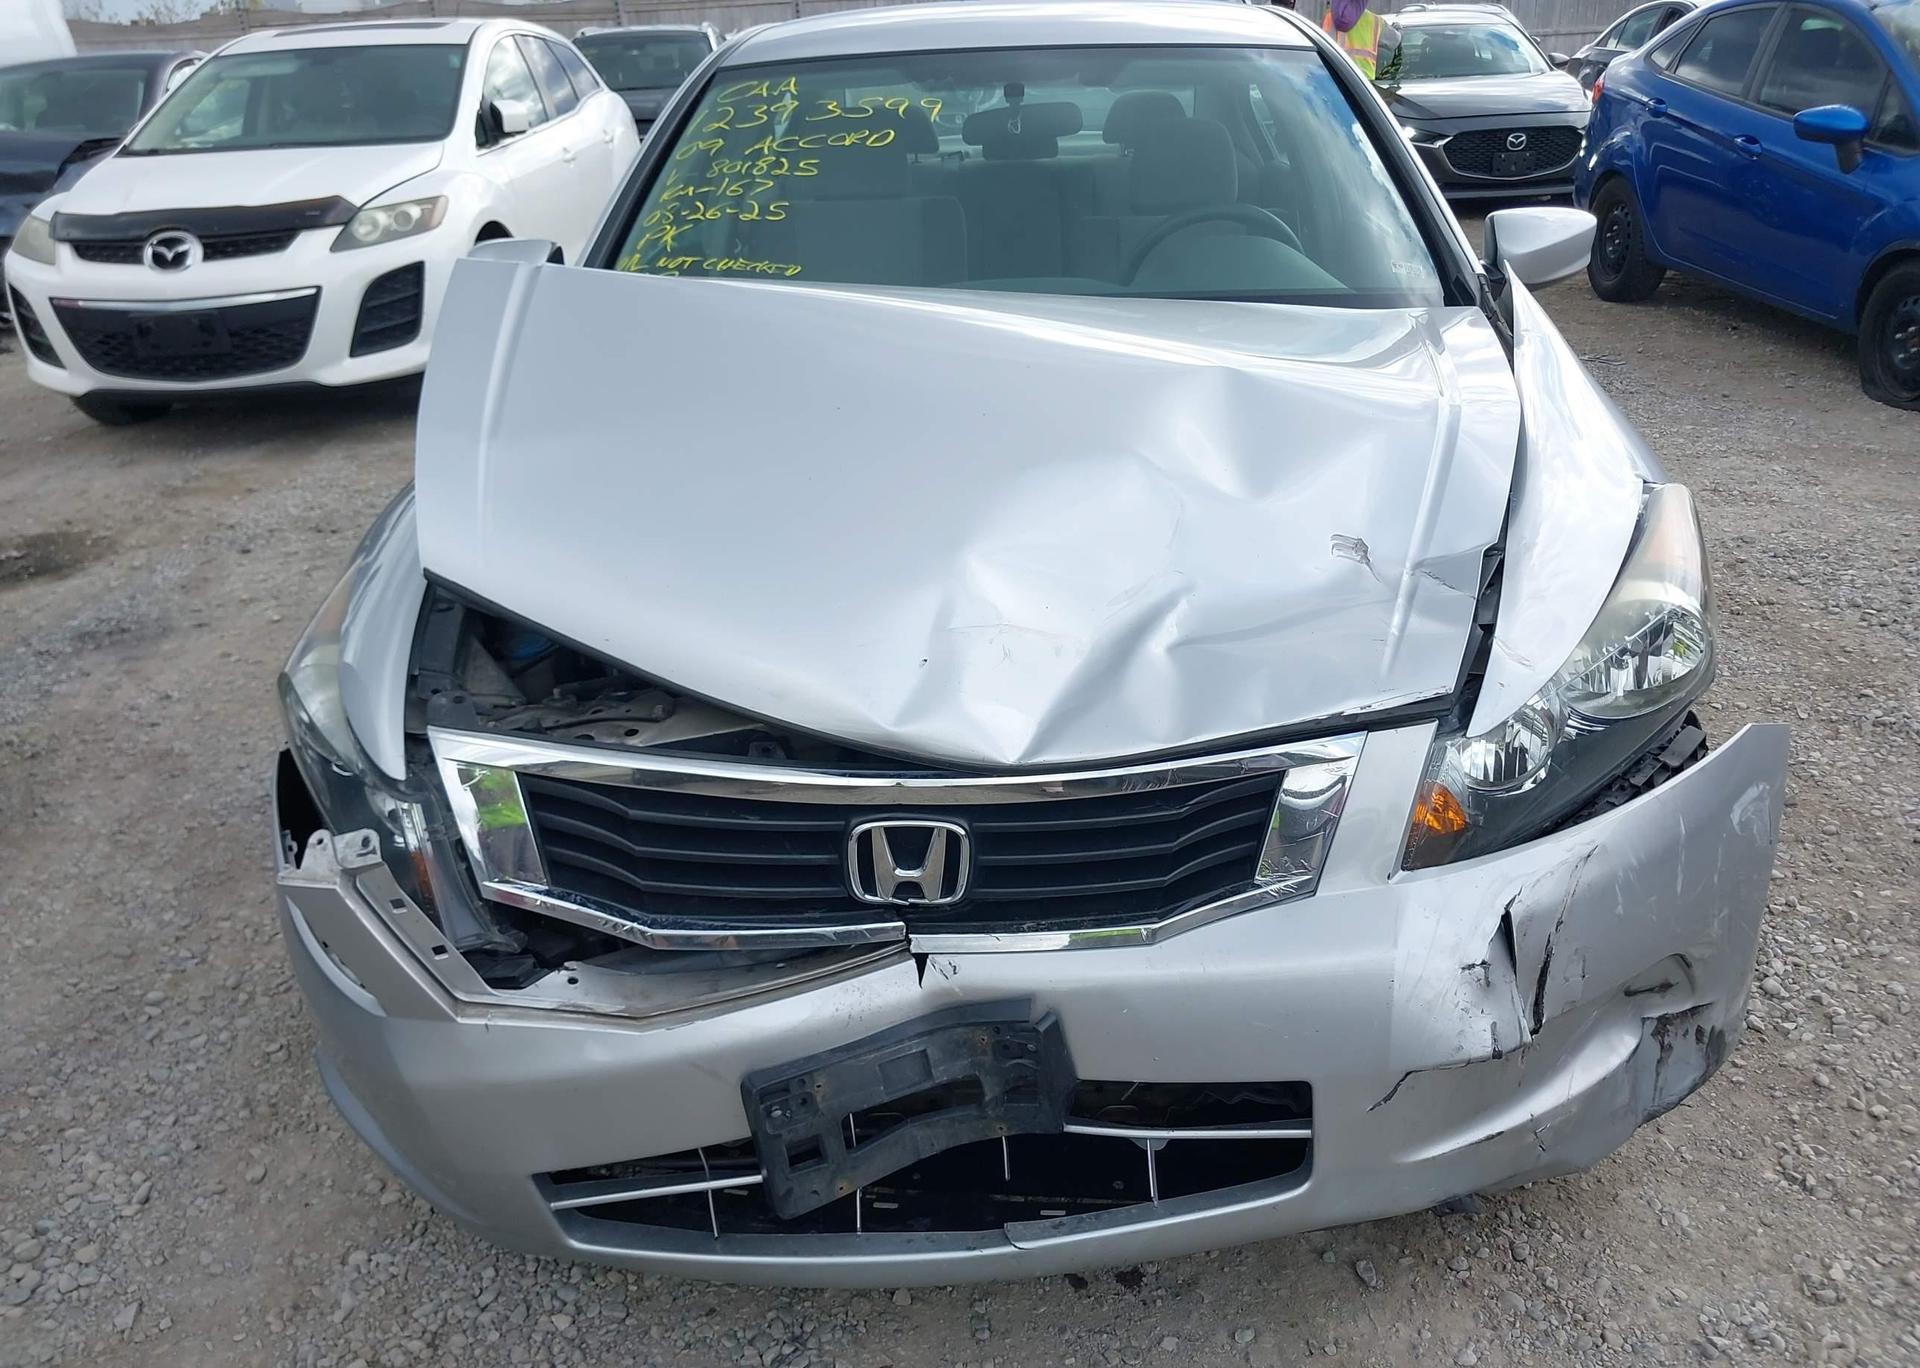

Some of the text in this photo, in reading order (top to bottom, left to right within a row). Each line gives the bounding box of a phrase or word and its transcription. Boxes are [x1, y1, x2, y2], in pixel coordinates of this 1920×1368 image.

[745, 129, 895, 155] ACCORD
[706, 157, 820, 178] 801825
[656, 256, 704, 270] NOT
